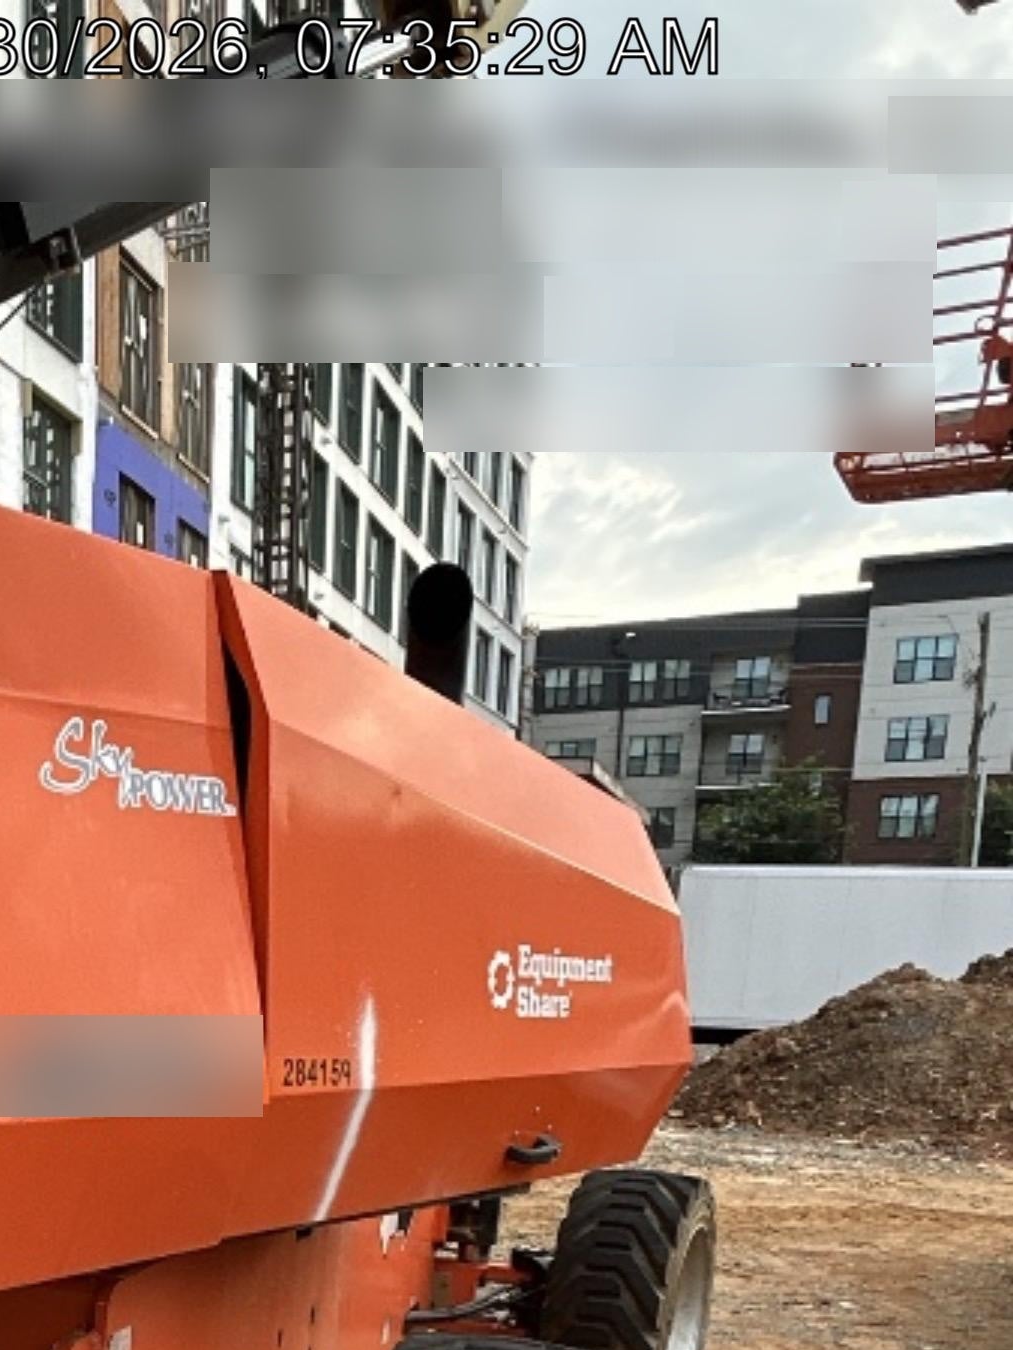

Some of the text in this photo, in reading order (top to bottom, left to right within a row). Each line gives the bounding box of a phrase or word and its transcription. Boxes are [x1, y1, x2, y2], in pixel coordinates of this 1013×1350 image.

[40, 716, 134, 809] Sky
[517, 943, 613, 988] Equipment
[516, 985, 571, 1018] Share
[282, 1057, 351, 1088] 284159
